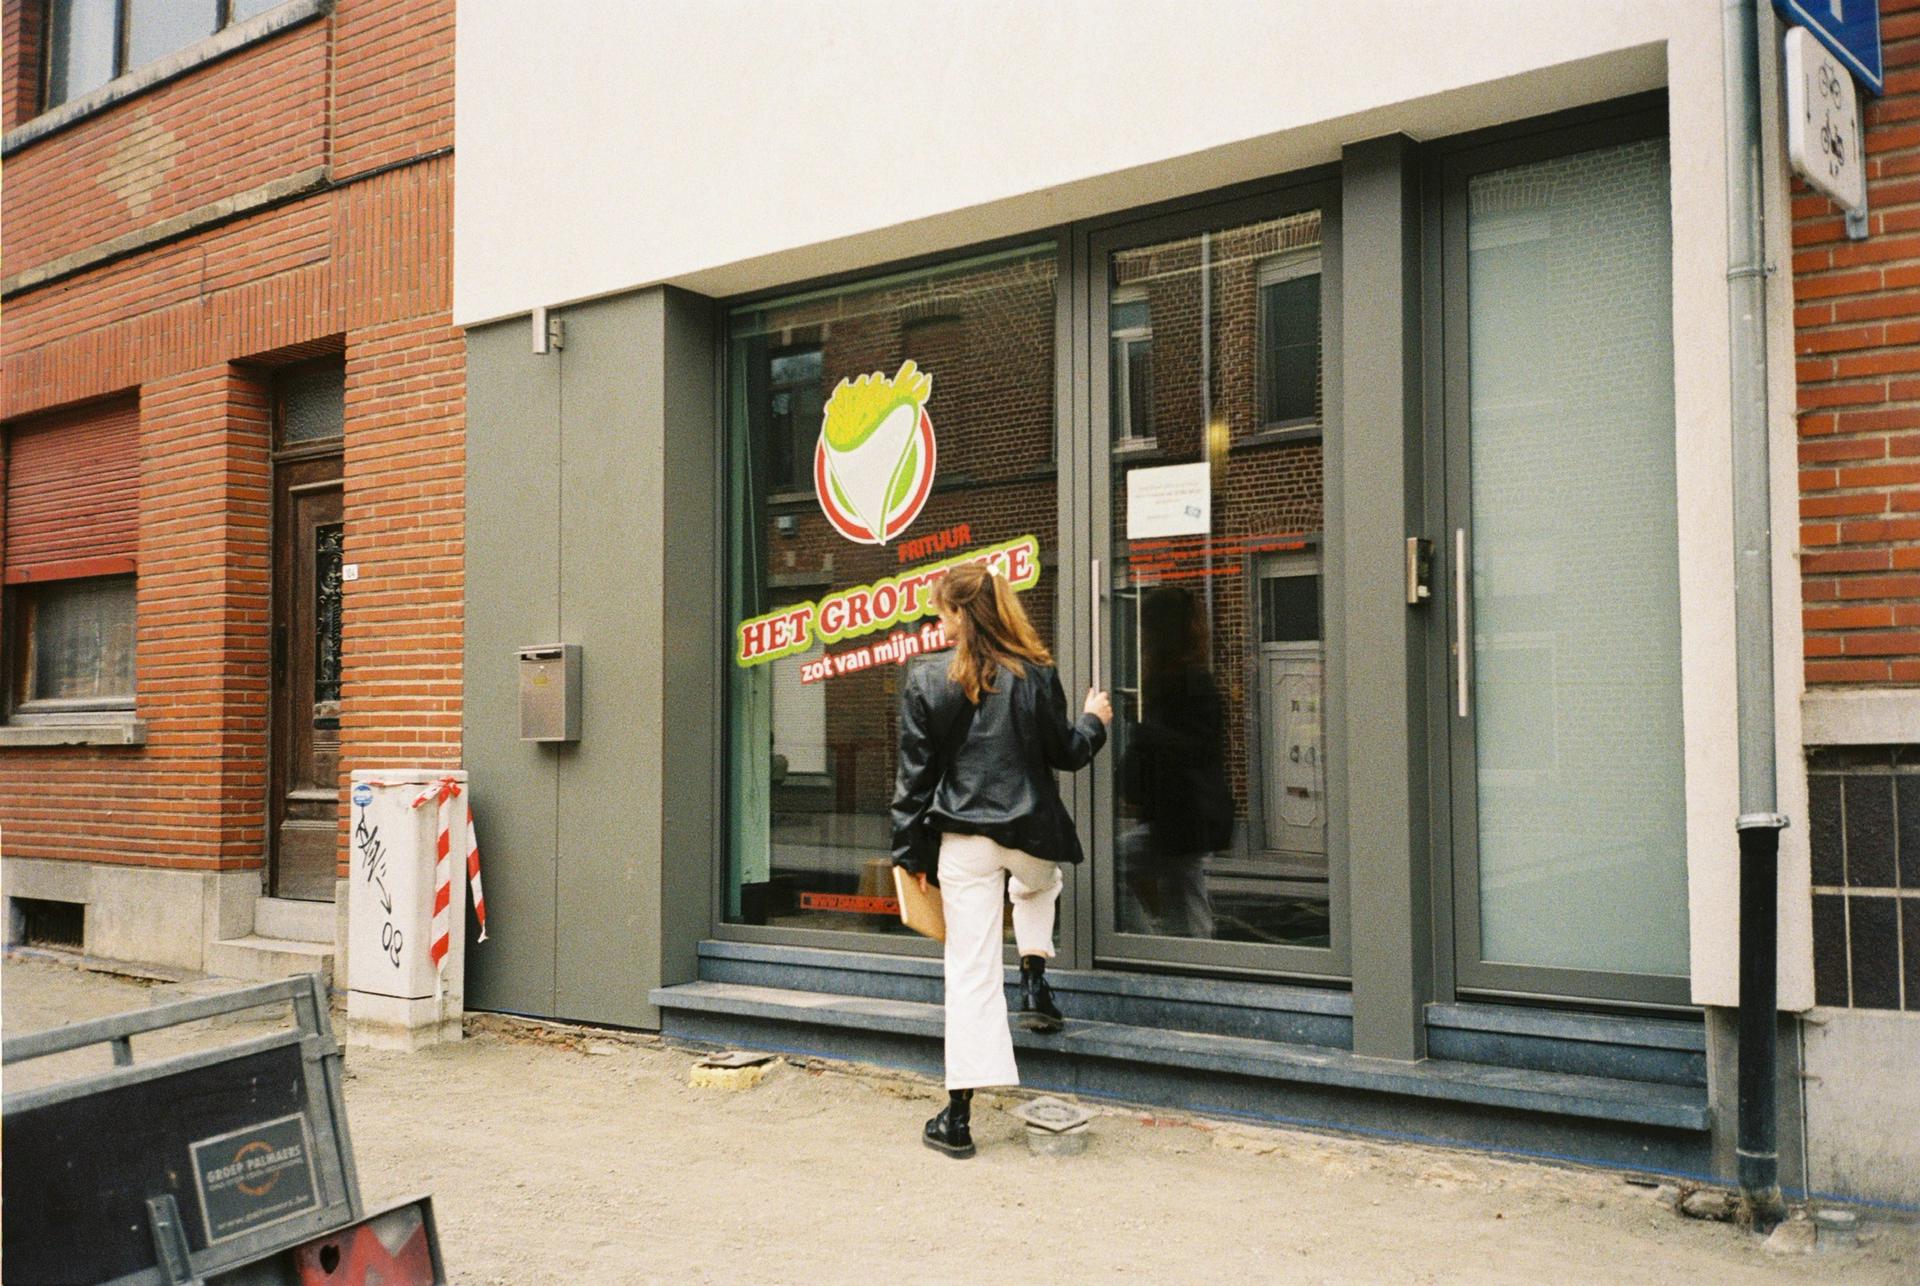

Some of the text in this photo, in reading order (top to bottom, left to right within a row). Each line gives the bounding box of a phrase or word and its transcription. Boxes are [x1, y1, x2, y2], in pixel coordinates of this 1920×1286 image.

[897, 523, 971, 564] FRITUUR
[741, 606, 812, 659] HET
[801, 657, 833, 683] zot
[834, 649, 871, 673] van
[874, 633, 919, 663] mijn
[206, 1161, 245, 1183] GROEP
